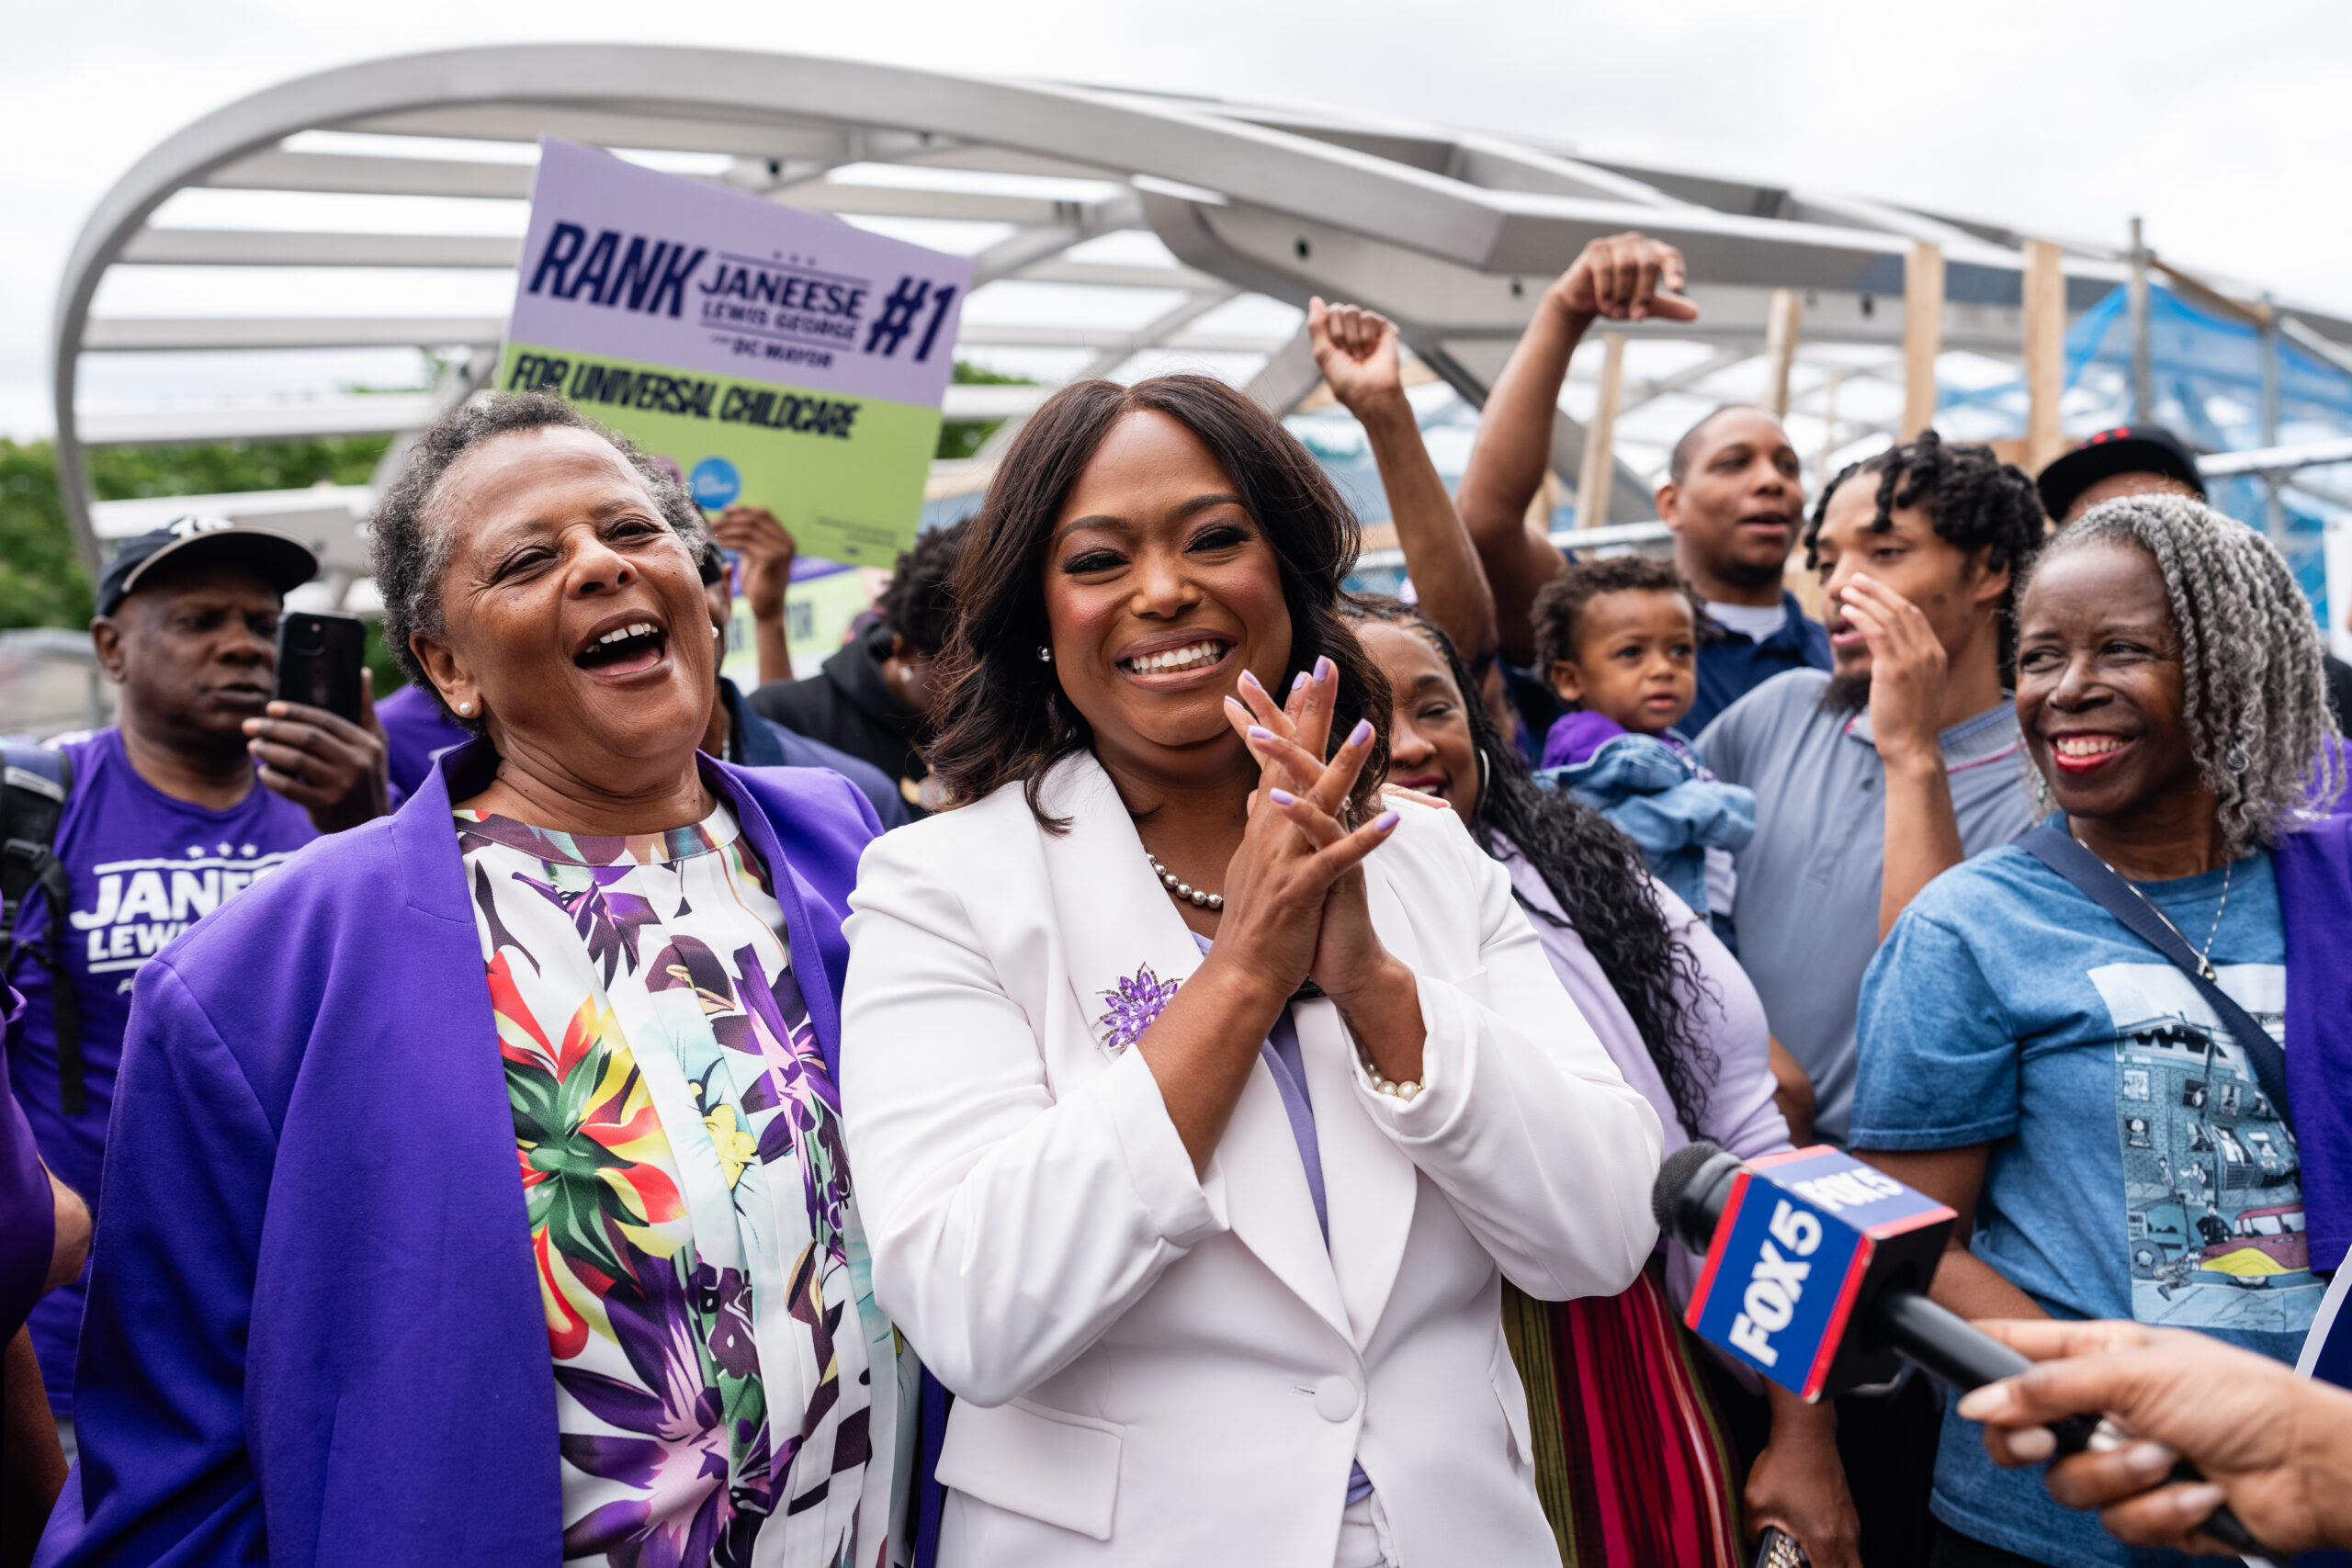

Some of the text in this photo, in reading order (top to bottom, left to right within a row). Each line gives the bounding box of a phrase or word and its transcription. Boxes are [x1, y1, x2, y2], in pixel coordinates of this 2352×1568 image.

[528, 221, 708, 319] RANK
[700, 264, 868, 320] JANEESE
[702, 300, 856, 342] LEWIS GEORGE
[864, 276, 957, 363] #1
[765, 344, 834, 367] MAYOR
[509, 354, 862, 440] FOR UNIVERSAL CHILDCARE
